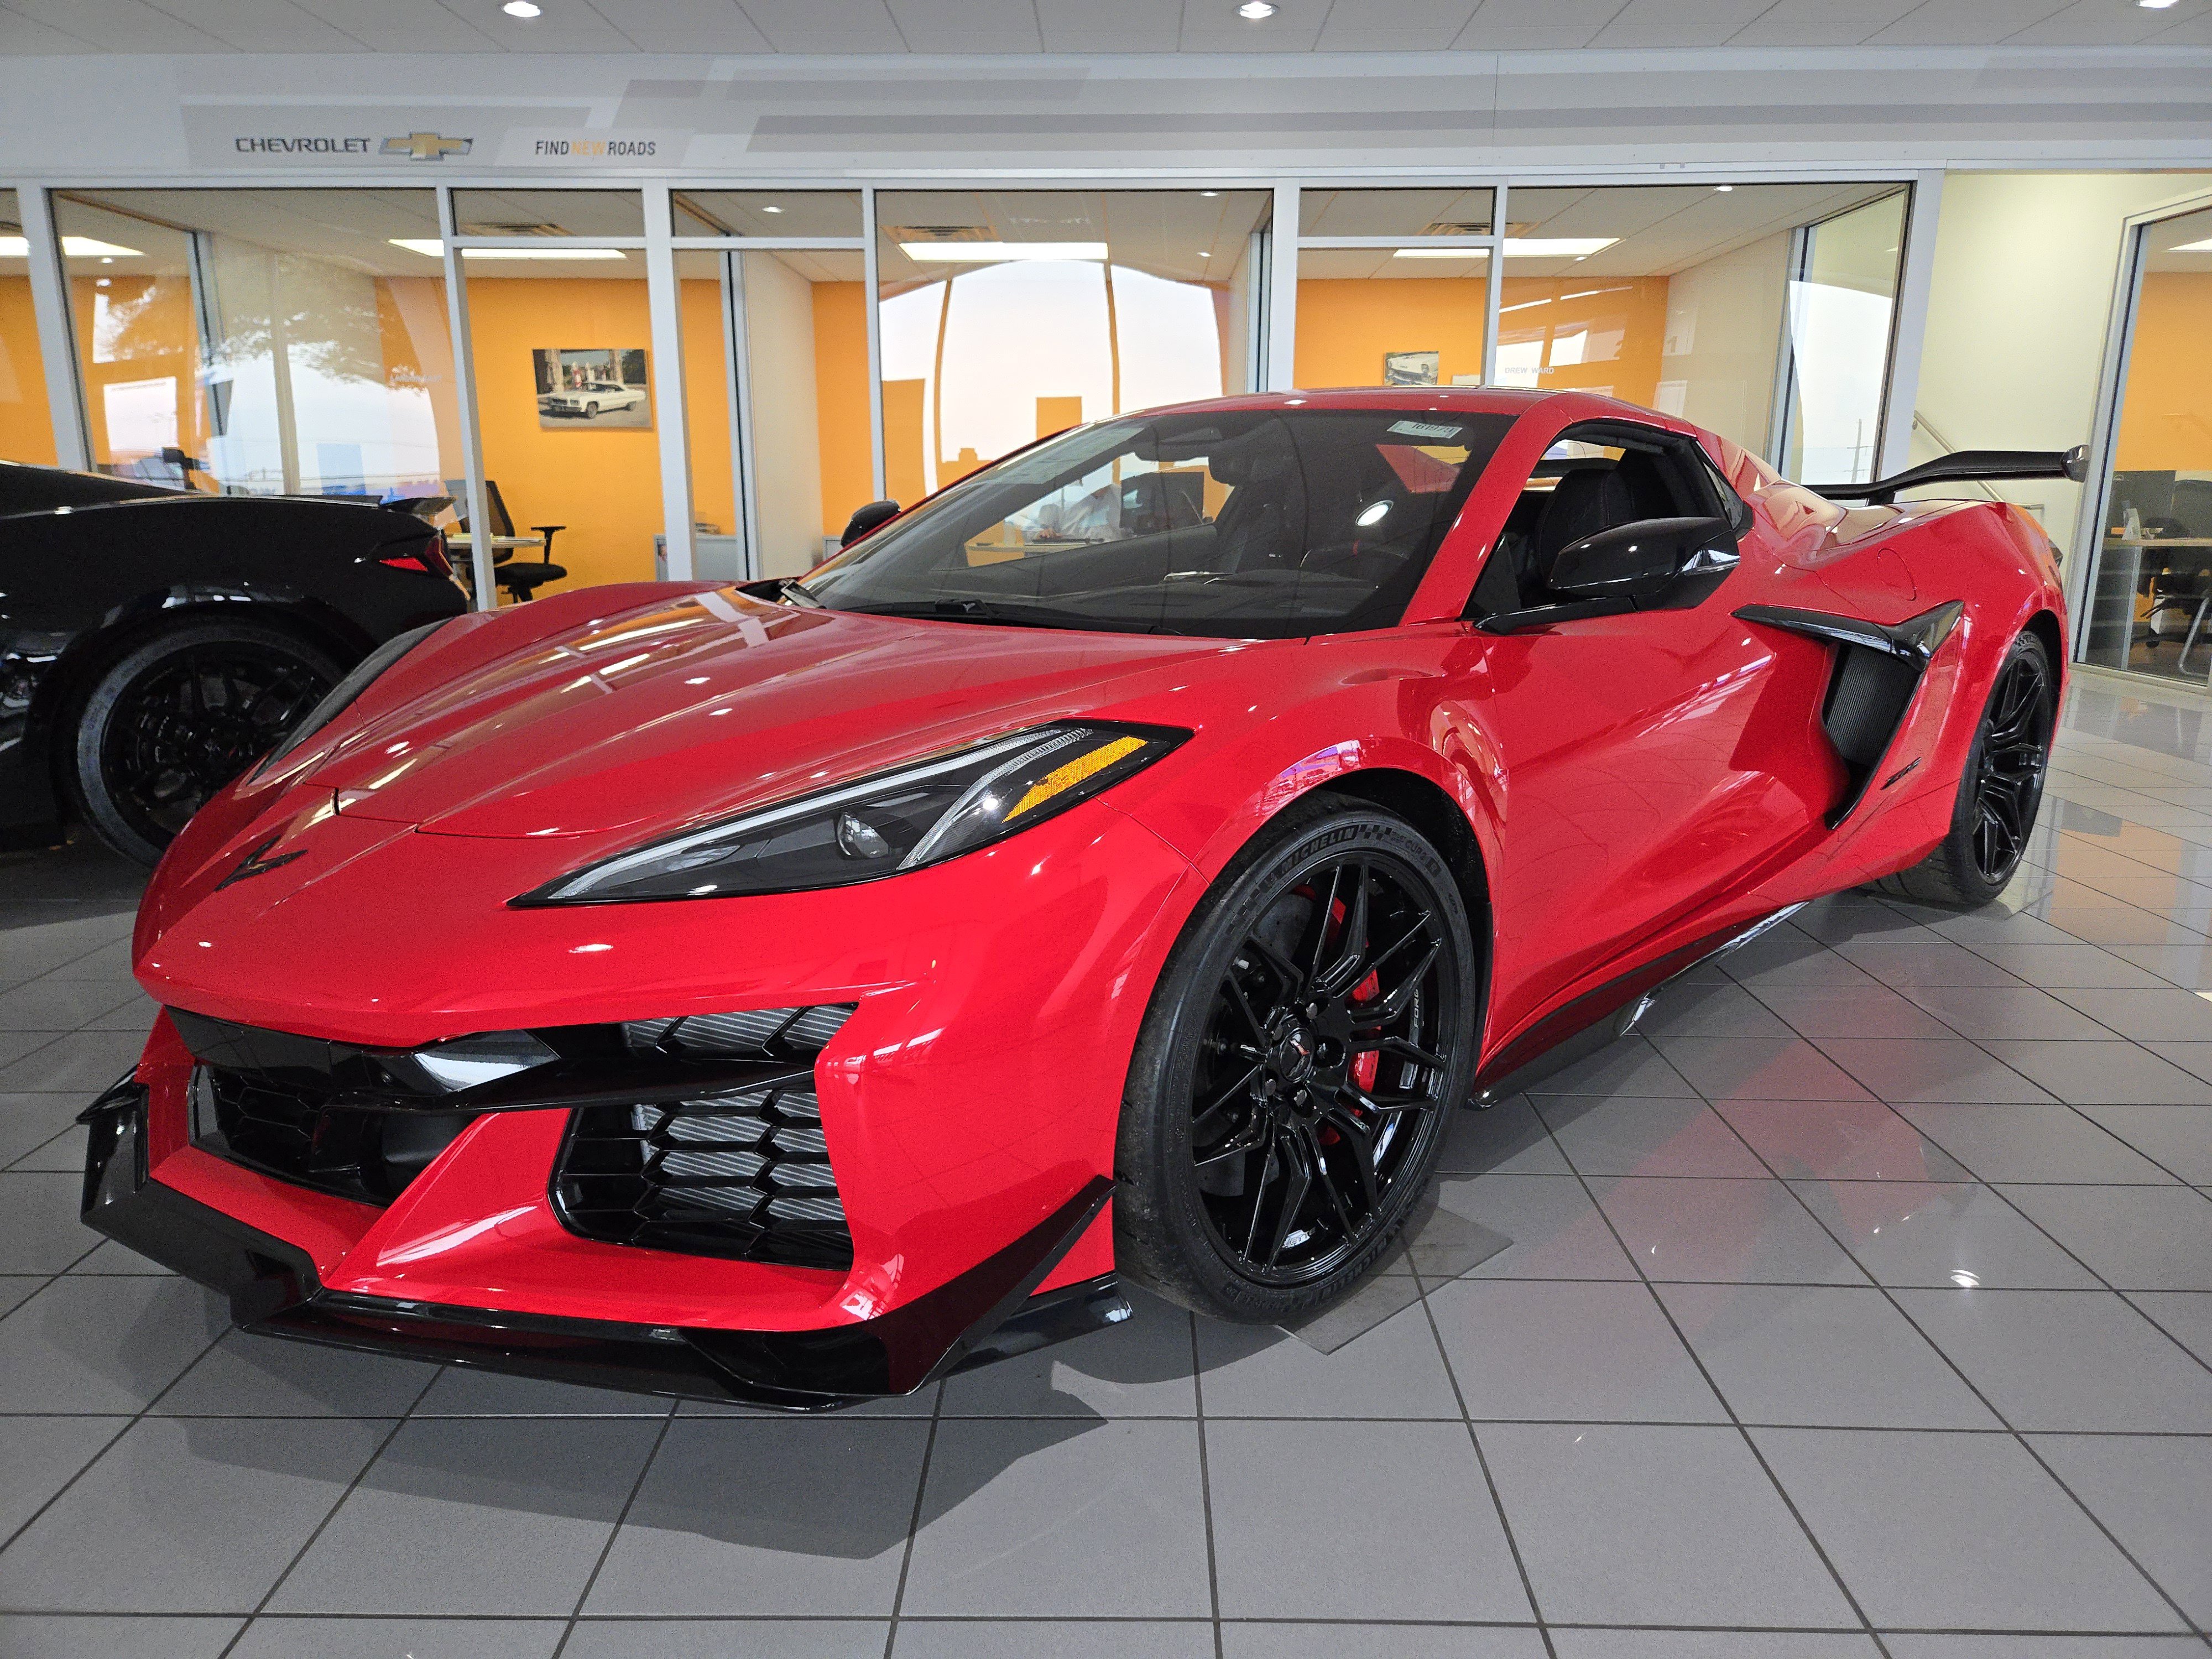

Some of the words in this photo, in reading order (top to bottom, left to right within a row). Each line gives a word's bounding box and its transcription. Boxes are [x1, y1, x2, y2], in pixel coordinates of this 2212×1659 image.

[236, 138, 371, 153] CHEVROLET
[536, 140, 570, 155] FIND
[571, 141, 606, 155] NEW
[608, 141, 656, 155] ROADS
[1281, 828, 1355, 874] MICHELIN
[1283, 1227, 1316, 1248] VETTE
